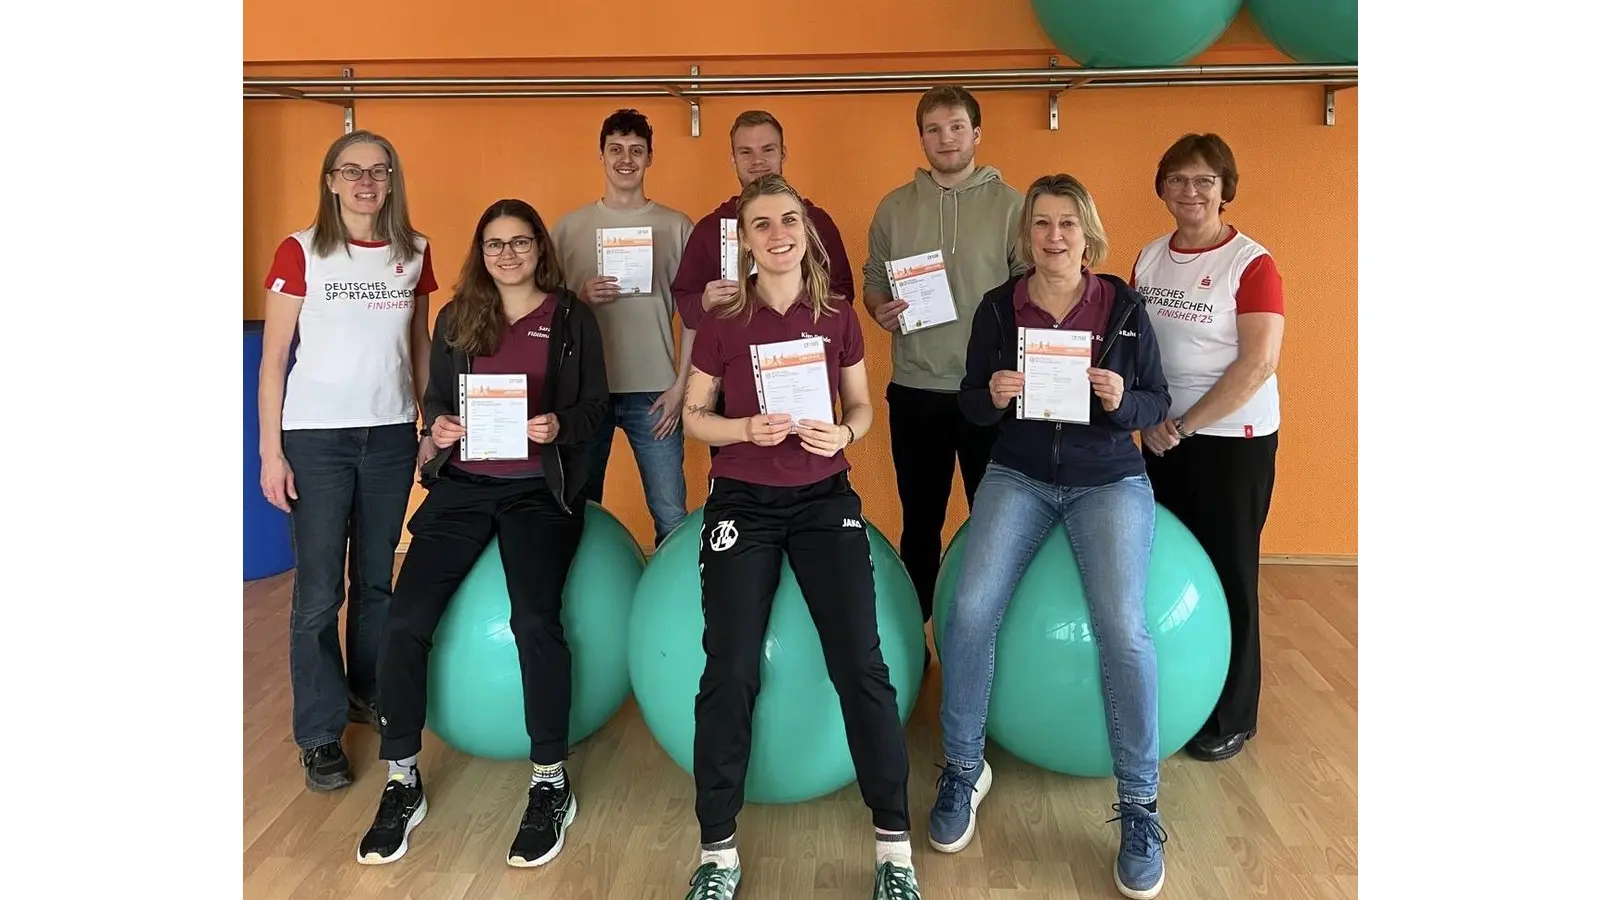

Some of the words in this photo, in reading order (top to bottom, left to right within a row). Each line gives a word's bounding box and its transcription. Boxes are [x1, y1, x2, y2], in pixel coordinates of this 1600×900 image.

[325, 282, 387, 291] DEUTSCHES
[1138, 286, 1185, 299] DEUTSCHES
[1145, 295, 1213, 313] ORTABZEICHEN
[842, 518, 862, 528] JAKO
